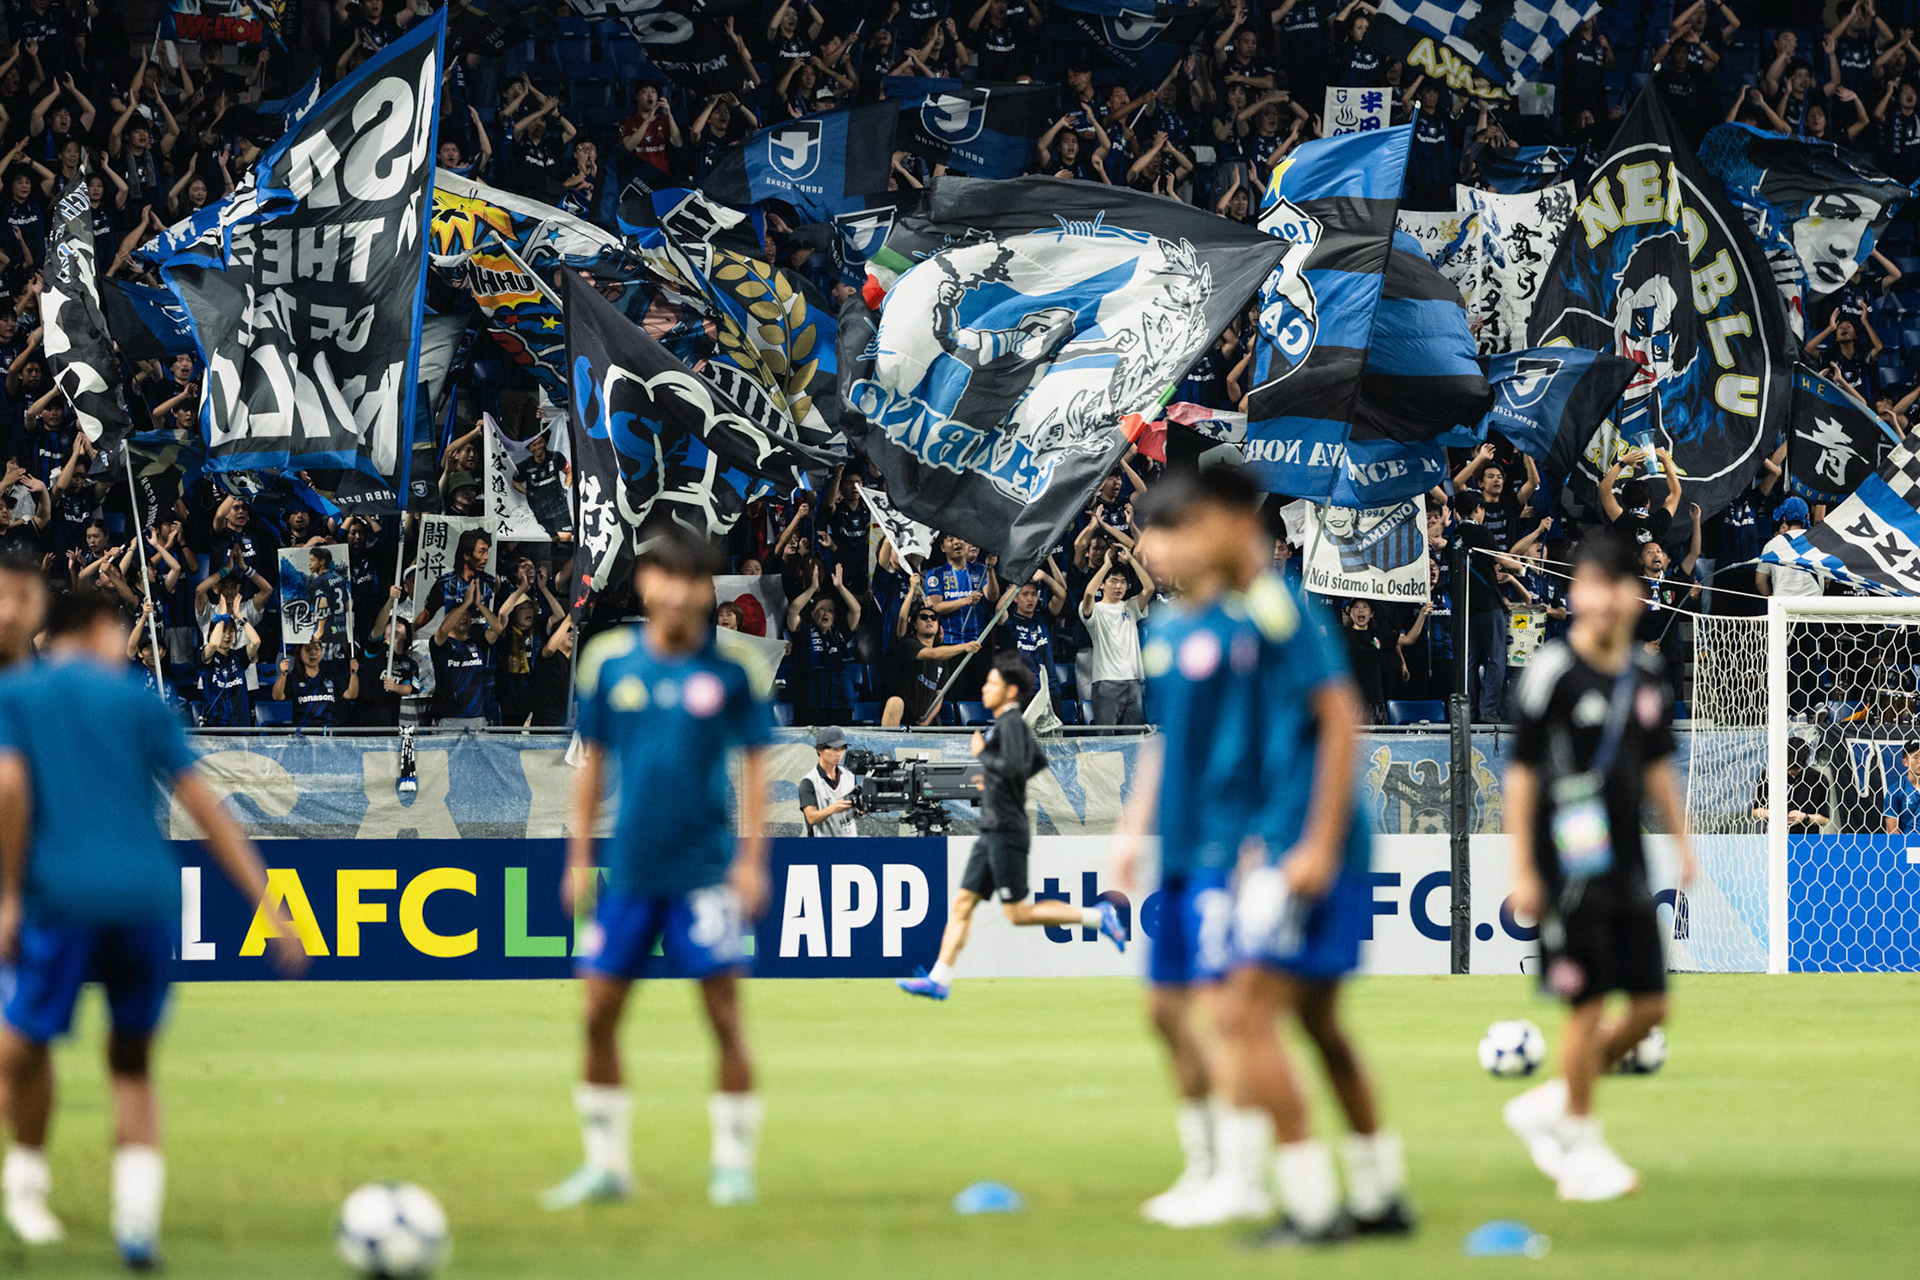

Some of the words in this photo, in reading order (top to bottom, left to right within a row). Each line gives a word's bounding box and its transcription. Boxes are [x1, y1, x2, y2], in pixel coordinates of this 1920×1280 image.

[174, 12, 263, 44] WELTON
[419, 521, 448, 580] 闘将
[944, 572, 957, 592] 39
[1309, 566, 1330, 585] Noi
[1331, 574, 1369, 591] siamo
[1372, 579, 1384, 595] la
[1388, 577, 1426, 597] Osaka
[282, 598, 332, 634] Riku
[334, 587, 344, 615] 3
[1397, 780, 1423, 805] SINCE
[239, 867, 478, 958] AFC
[779, 863, 930, 958] APP
